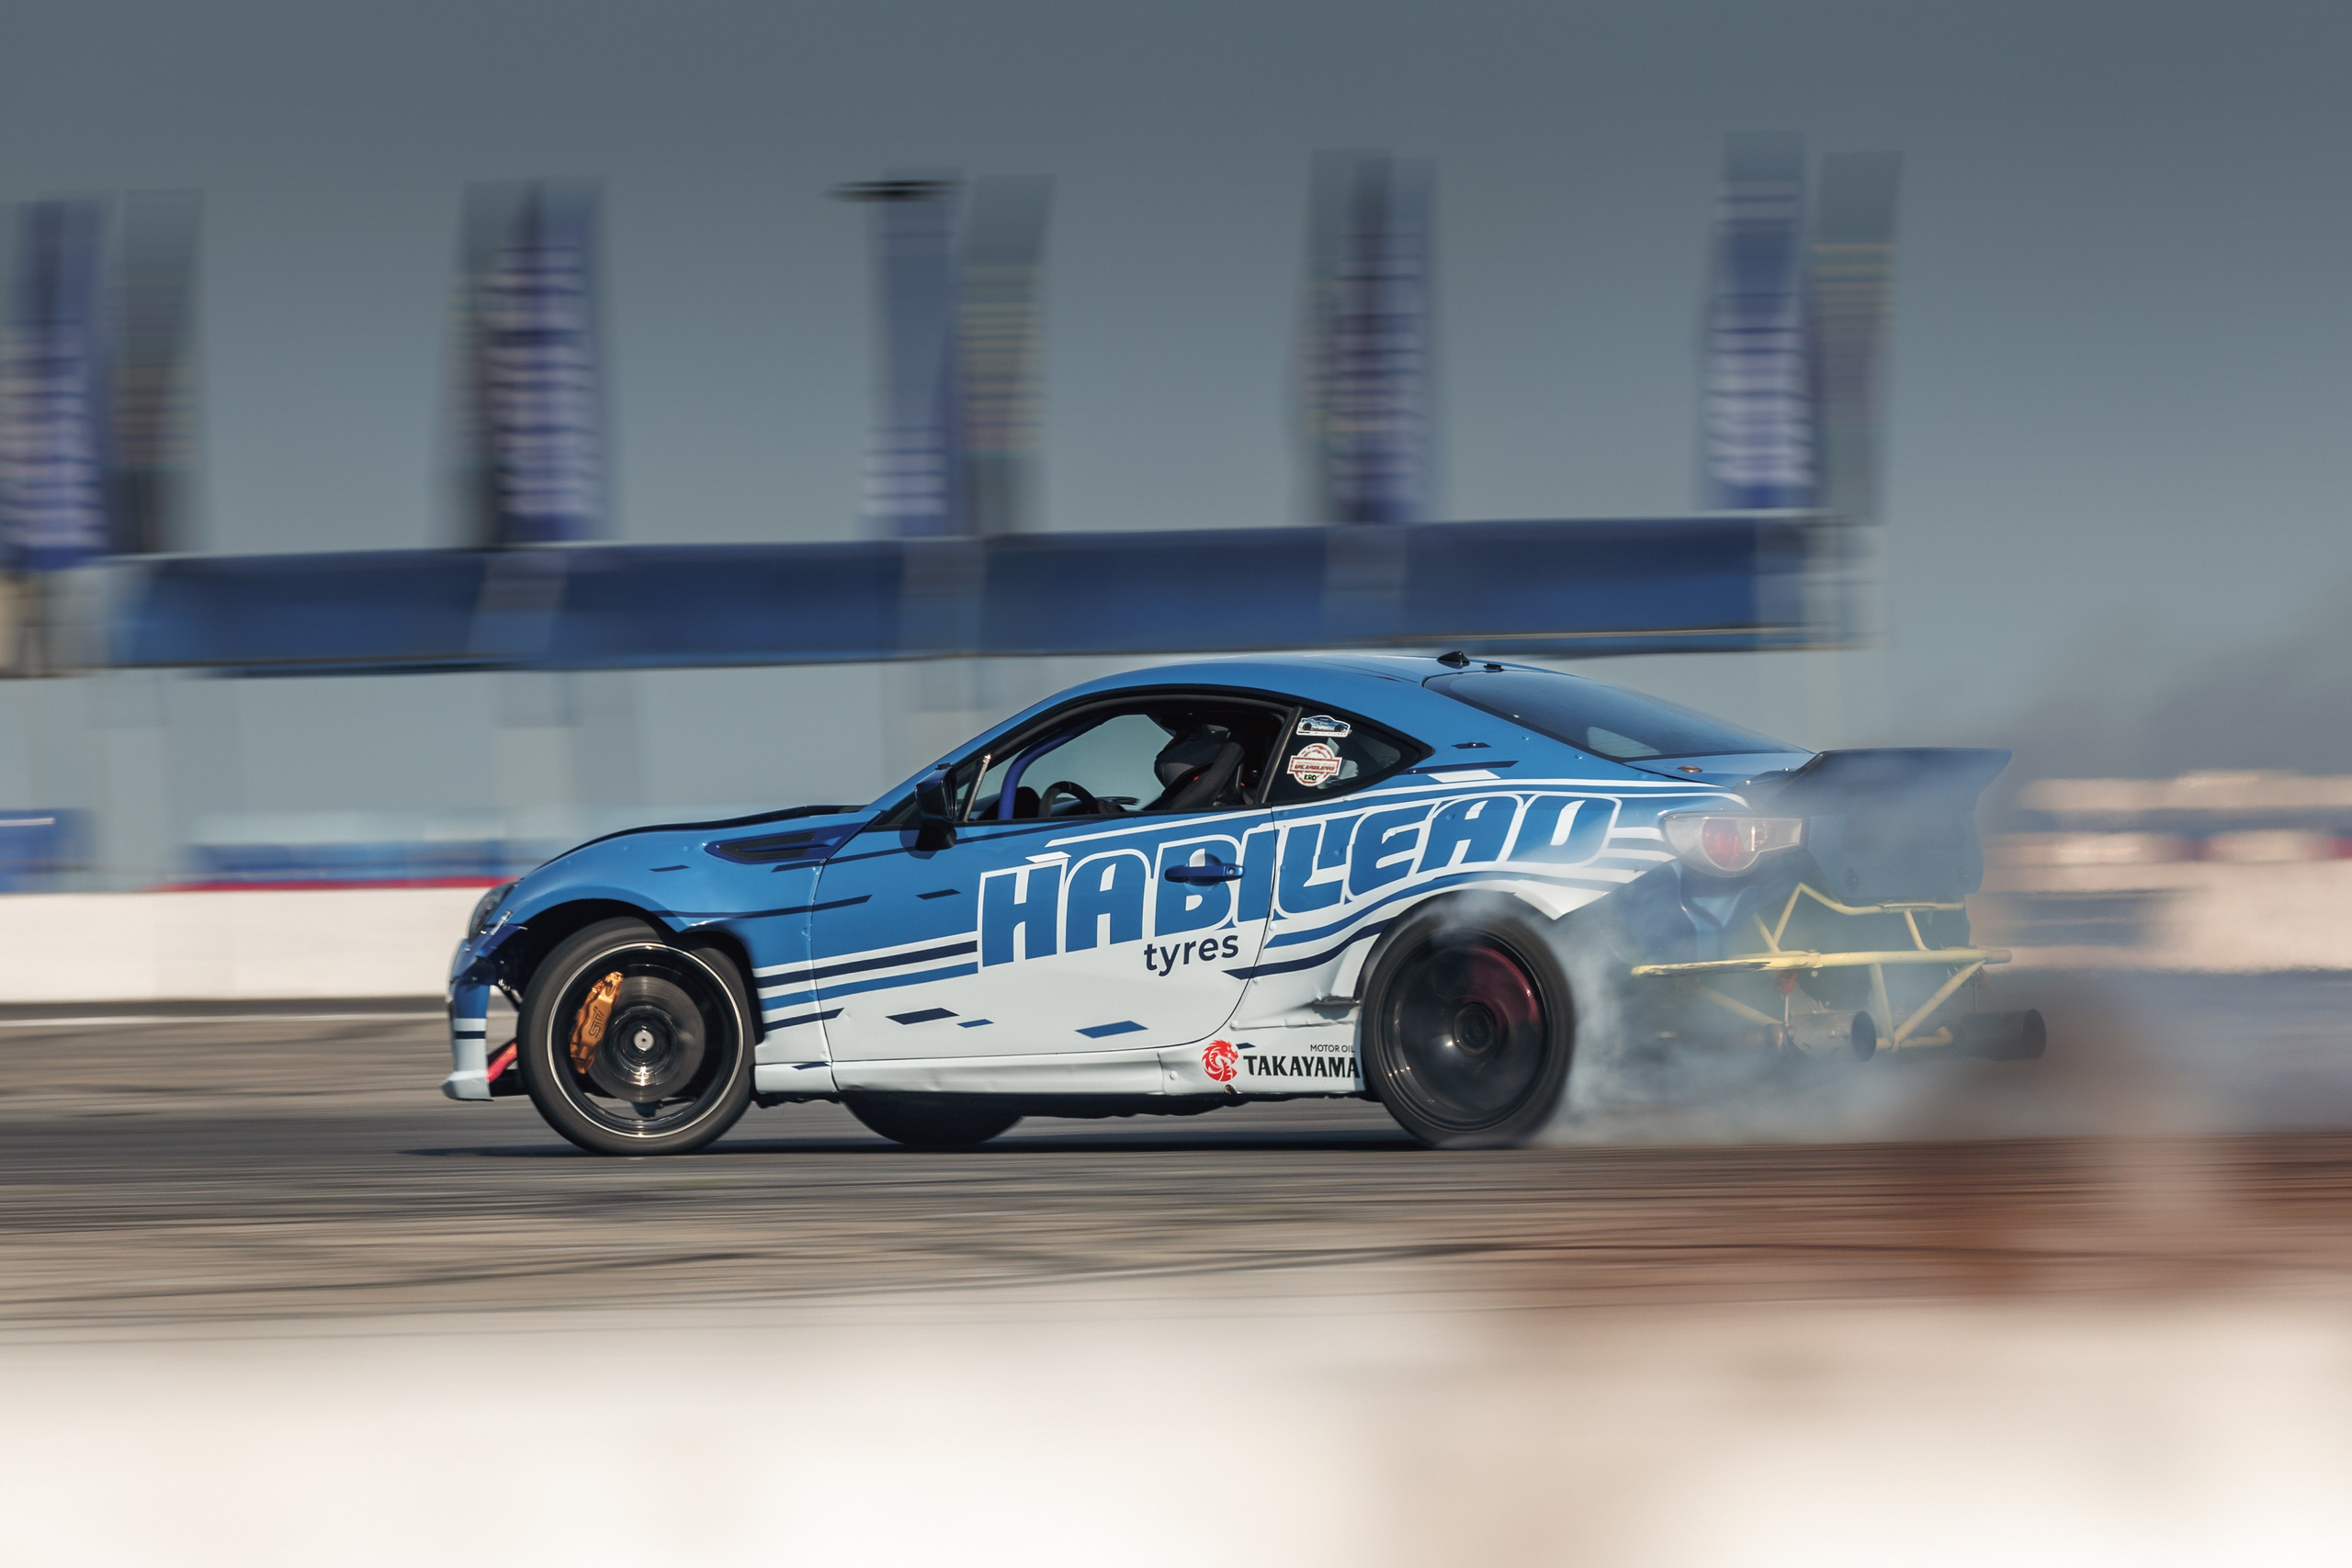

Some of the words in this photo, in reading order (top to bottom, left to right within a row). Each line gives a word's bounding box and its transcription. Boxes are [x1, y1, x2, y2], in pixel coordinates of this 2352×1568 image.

[981, 795, 1621, 967] HABILEAD
[1143, 934, 1238, 976] tyres
[1310, 1044, 1340, 1053] MOTOR
[1243, 1055, 1361, 1078] TAKAYAMA
